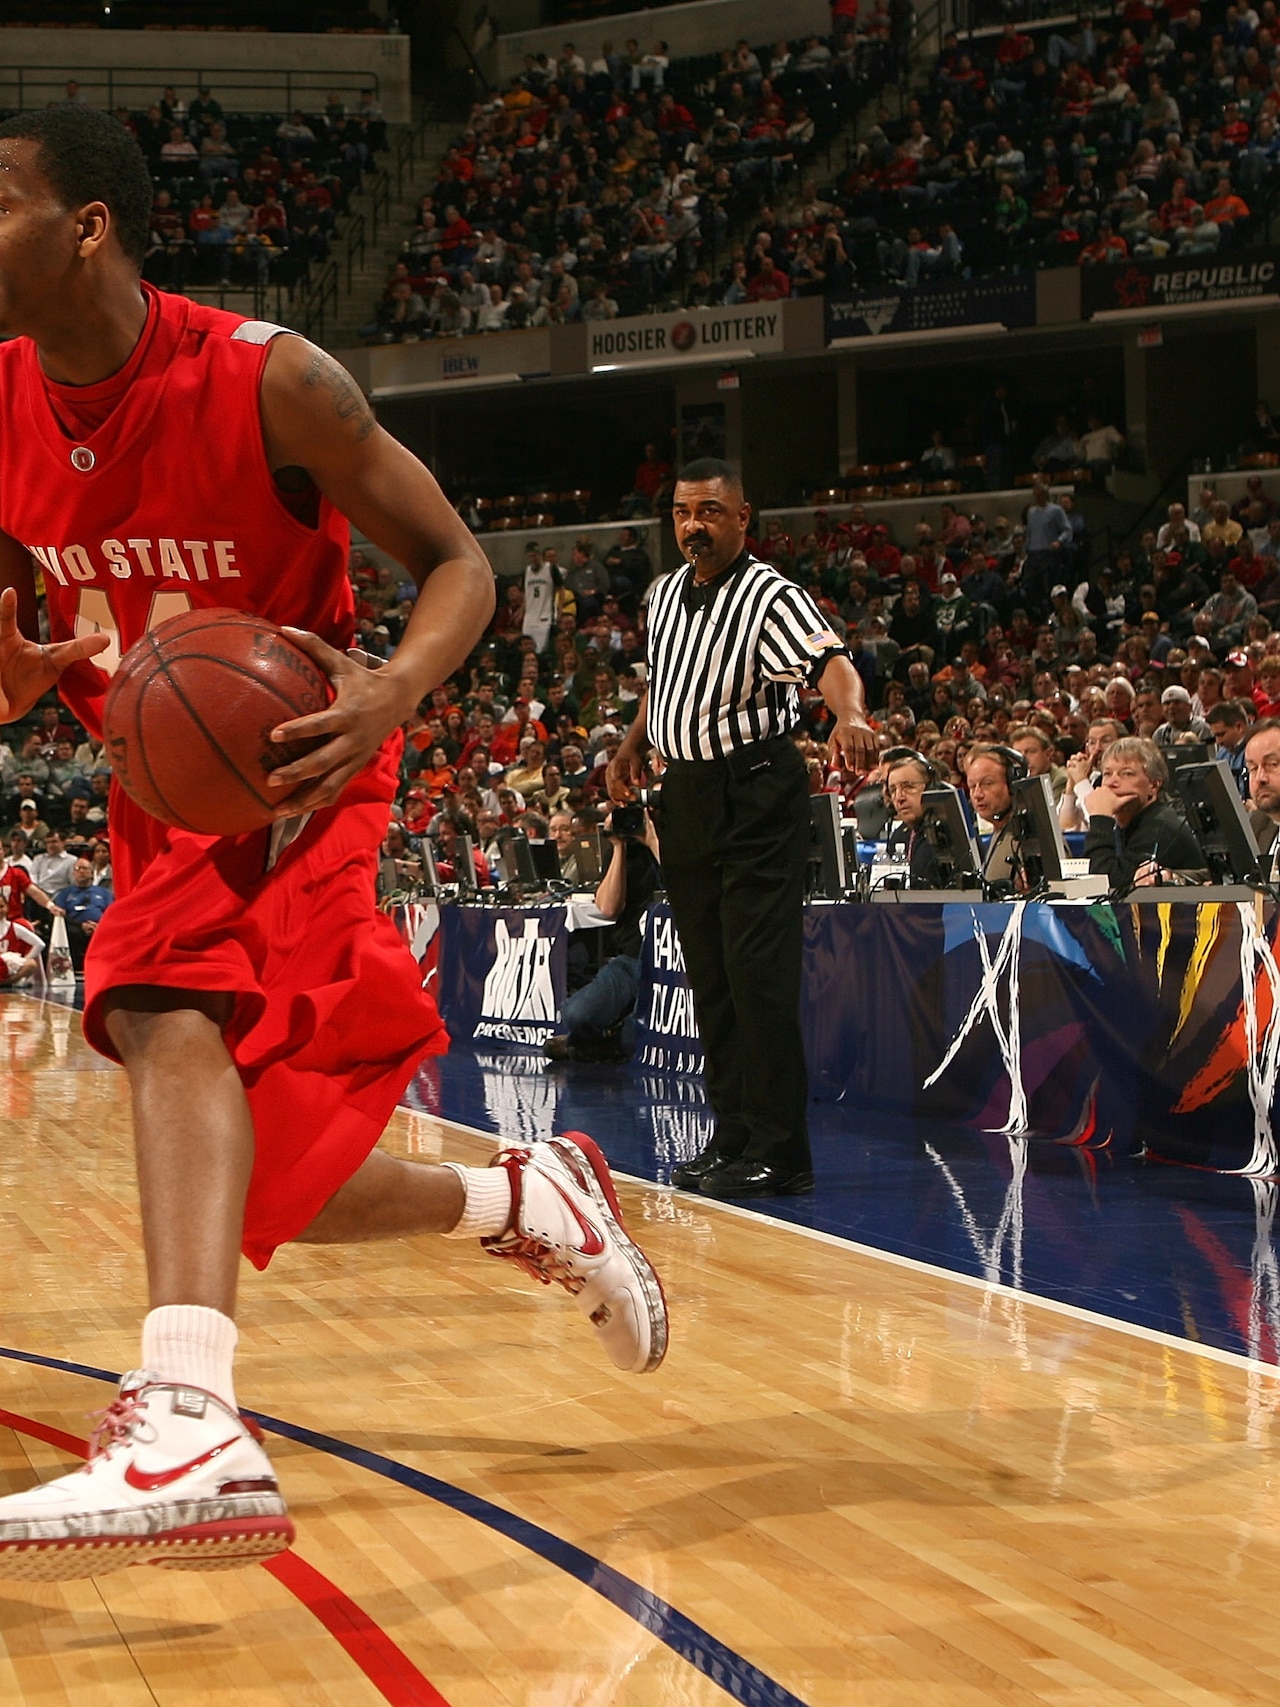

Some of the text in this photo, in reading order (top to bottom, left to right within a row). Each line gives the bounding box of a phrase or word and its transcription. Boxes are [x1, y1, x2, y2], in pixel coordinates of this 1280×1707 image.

[1153, 262, 1275, 292] REPUBLIC
[592, 313, 778, 355] HOOSIER LOTTERY
[101, 538, 242, 581] STATE
